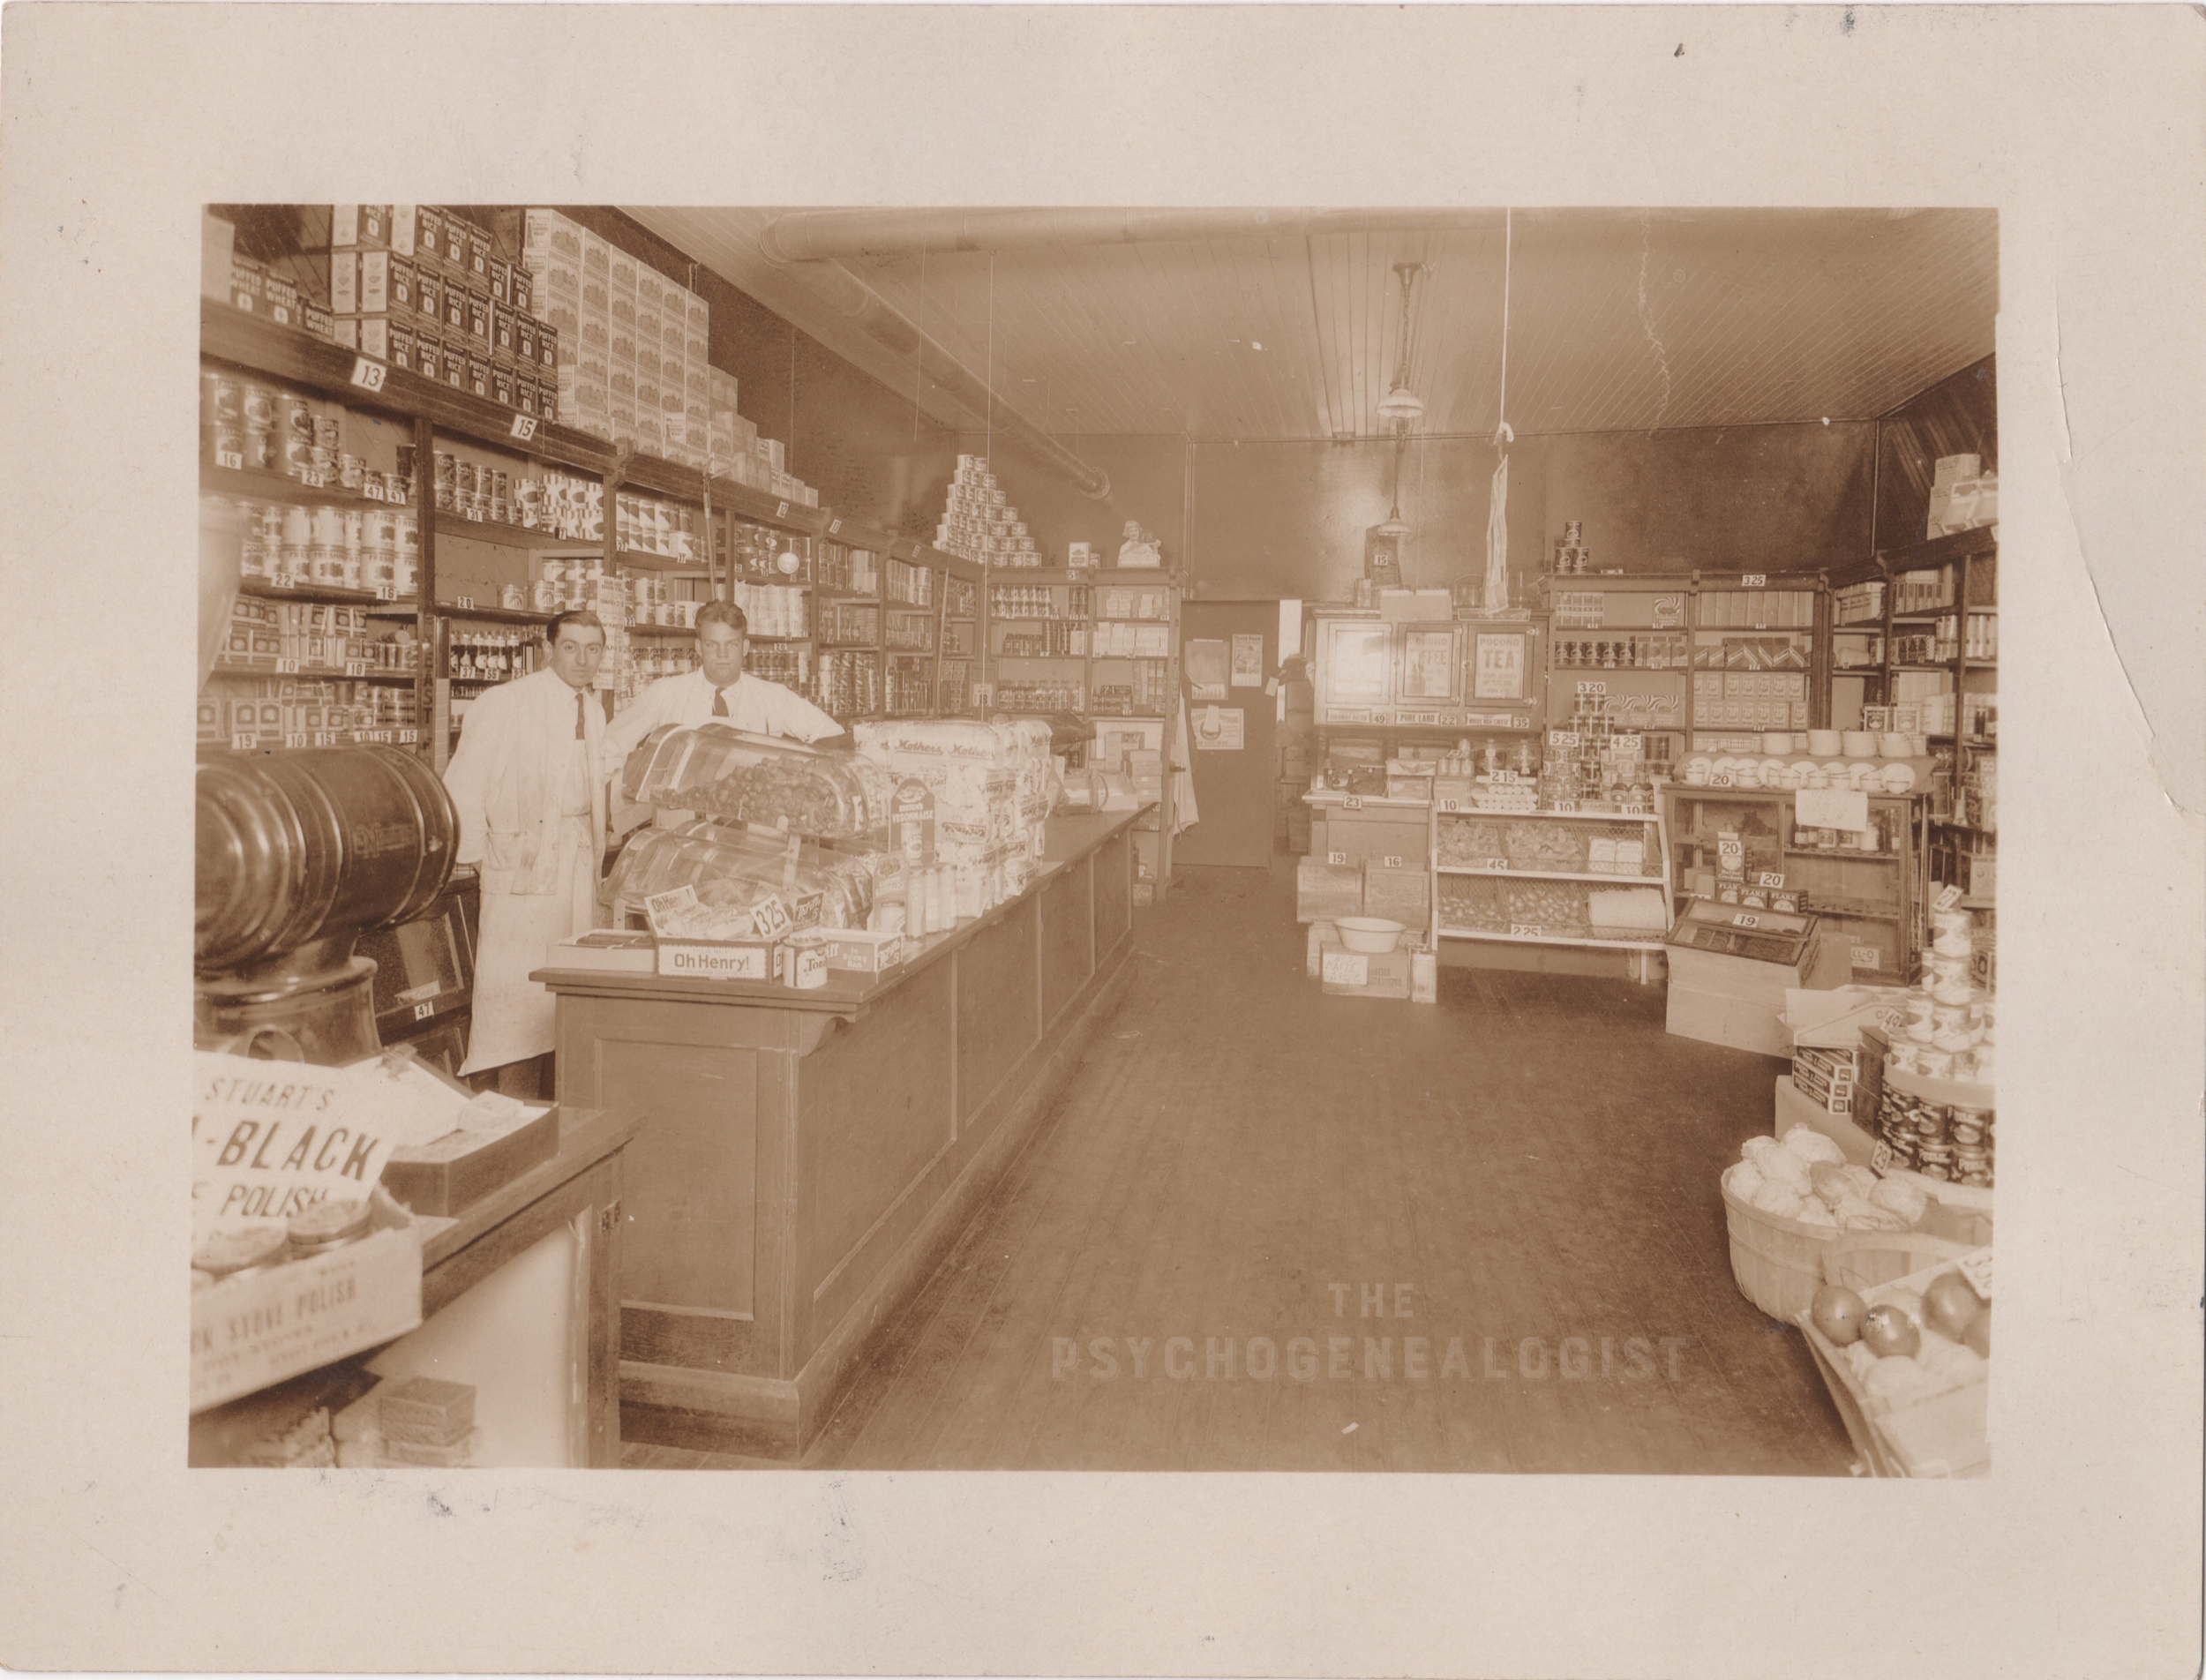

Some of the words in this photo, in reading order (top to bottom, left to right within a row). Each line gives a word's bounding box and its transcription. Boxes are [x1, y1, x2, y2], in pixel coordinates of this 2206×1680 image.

[365, 206, 381, 221] RICE
[417, 208, 441, 226] PUFFED
[422, 218, 437, 233] RICE
[445, 221, 467, 239] PUFFED
[448, 230, 462, 246] RICE
[470, 234, 490, 251] PUFFED
[473, 246, 486, 259] RICE
[390, 259, 414, 278] PUFFED
[394, 270, 410, 286] RICE
[417, 272, 440, 290] PUFFED
[491, 270, 505, 282] RICE
[514, 271, 531, 287] PUFFED
[266, 278, 296, 300] PUFFED
[421, 284, 436, 297] RICE
[445, 284, 466, 303] PUFFED
[516, 282, 529, 294] RICE
[266, 291, 296, 310] WHEAT
[448, 296, 462, 310] RICE
[469, 296, 489, 313] PUFFED
[305, 308, 334, 326] PUFFED
[472, 308, 485, 320] RICE
[496, 310, 514, 325] PUFFED
[305, 320, 333, 337] WHEAT
[499, 320, 511, 331] RICE
[517, 319, 536, 335] PUFFED
[390, 327, 413, 345] PUFFED
[521, 330, 533, 341] RICE
[538, 330, 557, 344] PUFFED
[394, 340, 409, 353] RICE
[416, 339, 440, 355] PUFFED
[542, 341, 554, 350] RICE
[421, 351, 437, 363] RICE
[444, 349, 465, 365] PUFFED
[447, 361, 461, 372] RICE
[469, 360, 489, 374] PUFFED
[362, 365, 381, 386] 13
[473, 370, 486, 381] RICE
[493, 369, 513, 384] PUFFED
[497, 379, 510, 390] RICE
[517, 379, 536, 392] PUFFED
[521, 388, 533, 399] RICE
[539, 386, 558, 401] PUFFED
[542, 396, 554, 406] RICE
[518, 418, 533, 437] 15
[1937, 457, 1959, 469] JELL-O
[307, 473, 320, 484] 23
[368, 486, 380, 499] 47
[391, 491, 402, 503] 47
[469, 510, 479, 521] 31
[778, 504, 788, 515] 12
[832, 520, 840, 532] 13
[275, 574, 291, 587] 22
[460, 596, 472, 608] 20
[1483, 650, 1515, 669] TEA
[282, 660, 296, 673] 10
[351, 664, 363, 675] 10
[462, 668, 474, 678] 37
[486, 670, 498, 679] 55
[514, 671, 524, 679] 23
[1579, 683, 1587, 693] 3
[1589, 683, 1603, 693] 20
[979, 694, 987, 705] 18
[1400, 714, 1415, 723] PURE
[1442, 716, 1455, 725] 22
[1516, 718, 1527, 727] 35
[238, 735, 252, 748] 19
[291, 734, 304, 746] 10
[320, 733, 333, 745] 15
[379, 732, 389, 743] 15
[404, 731, 415, 742] 15
[1552, 733, 1559, 744] 5
[1561, 734, 1576, 745] 25
[1613, 737, 1620, 748] 4
[1623, 737, 1639, 747] 25
[1491, 770, 1500, 782] 2
[1502, 771, 1516, 783] 15
[1712, 775, 1729, 785] 20
[1346, 797, 1360, 807] 23
[1444, 799, 1457, 810] 10
[1559, 803, 1572, 812] 10
[892, 810, 934, 823] VEGONNAISE
[1722, 844, 1738, 854] 20
[1332, 854, 1344, 864] 19
[1388, 858, 1400, 866] 16
[1489, 859, 1504, 869] 45
[1764, 874, 1782, 887] 20
[1741, 889, 1767, 897] FLAKE
[1771, 893, 1797, 902] FLAKE
[756, 911, 770, 934] 3
[765, 900, 785, 930] 25
[1739, 915, 1756, 926] 19
[1525, 926, 1538, 936] 25
[674, 953, 695, 968] Oh
[699, 954, 749, 971] Henry!
[416, 987, 434, 999] CHIEF
[418, 1003, 430, 1016] 47
[206, 1076, 335, 1111] STUART'S
[1874, 1149, 1888, 1166] 29
